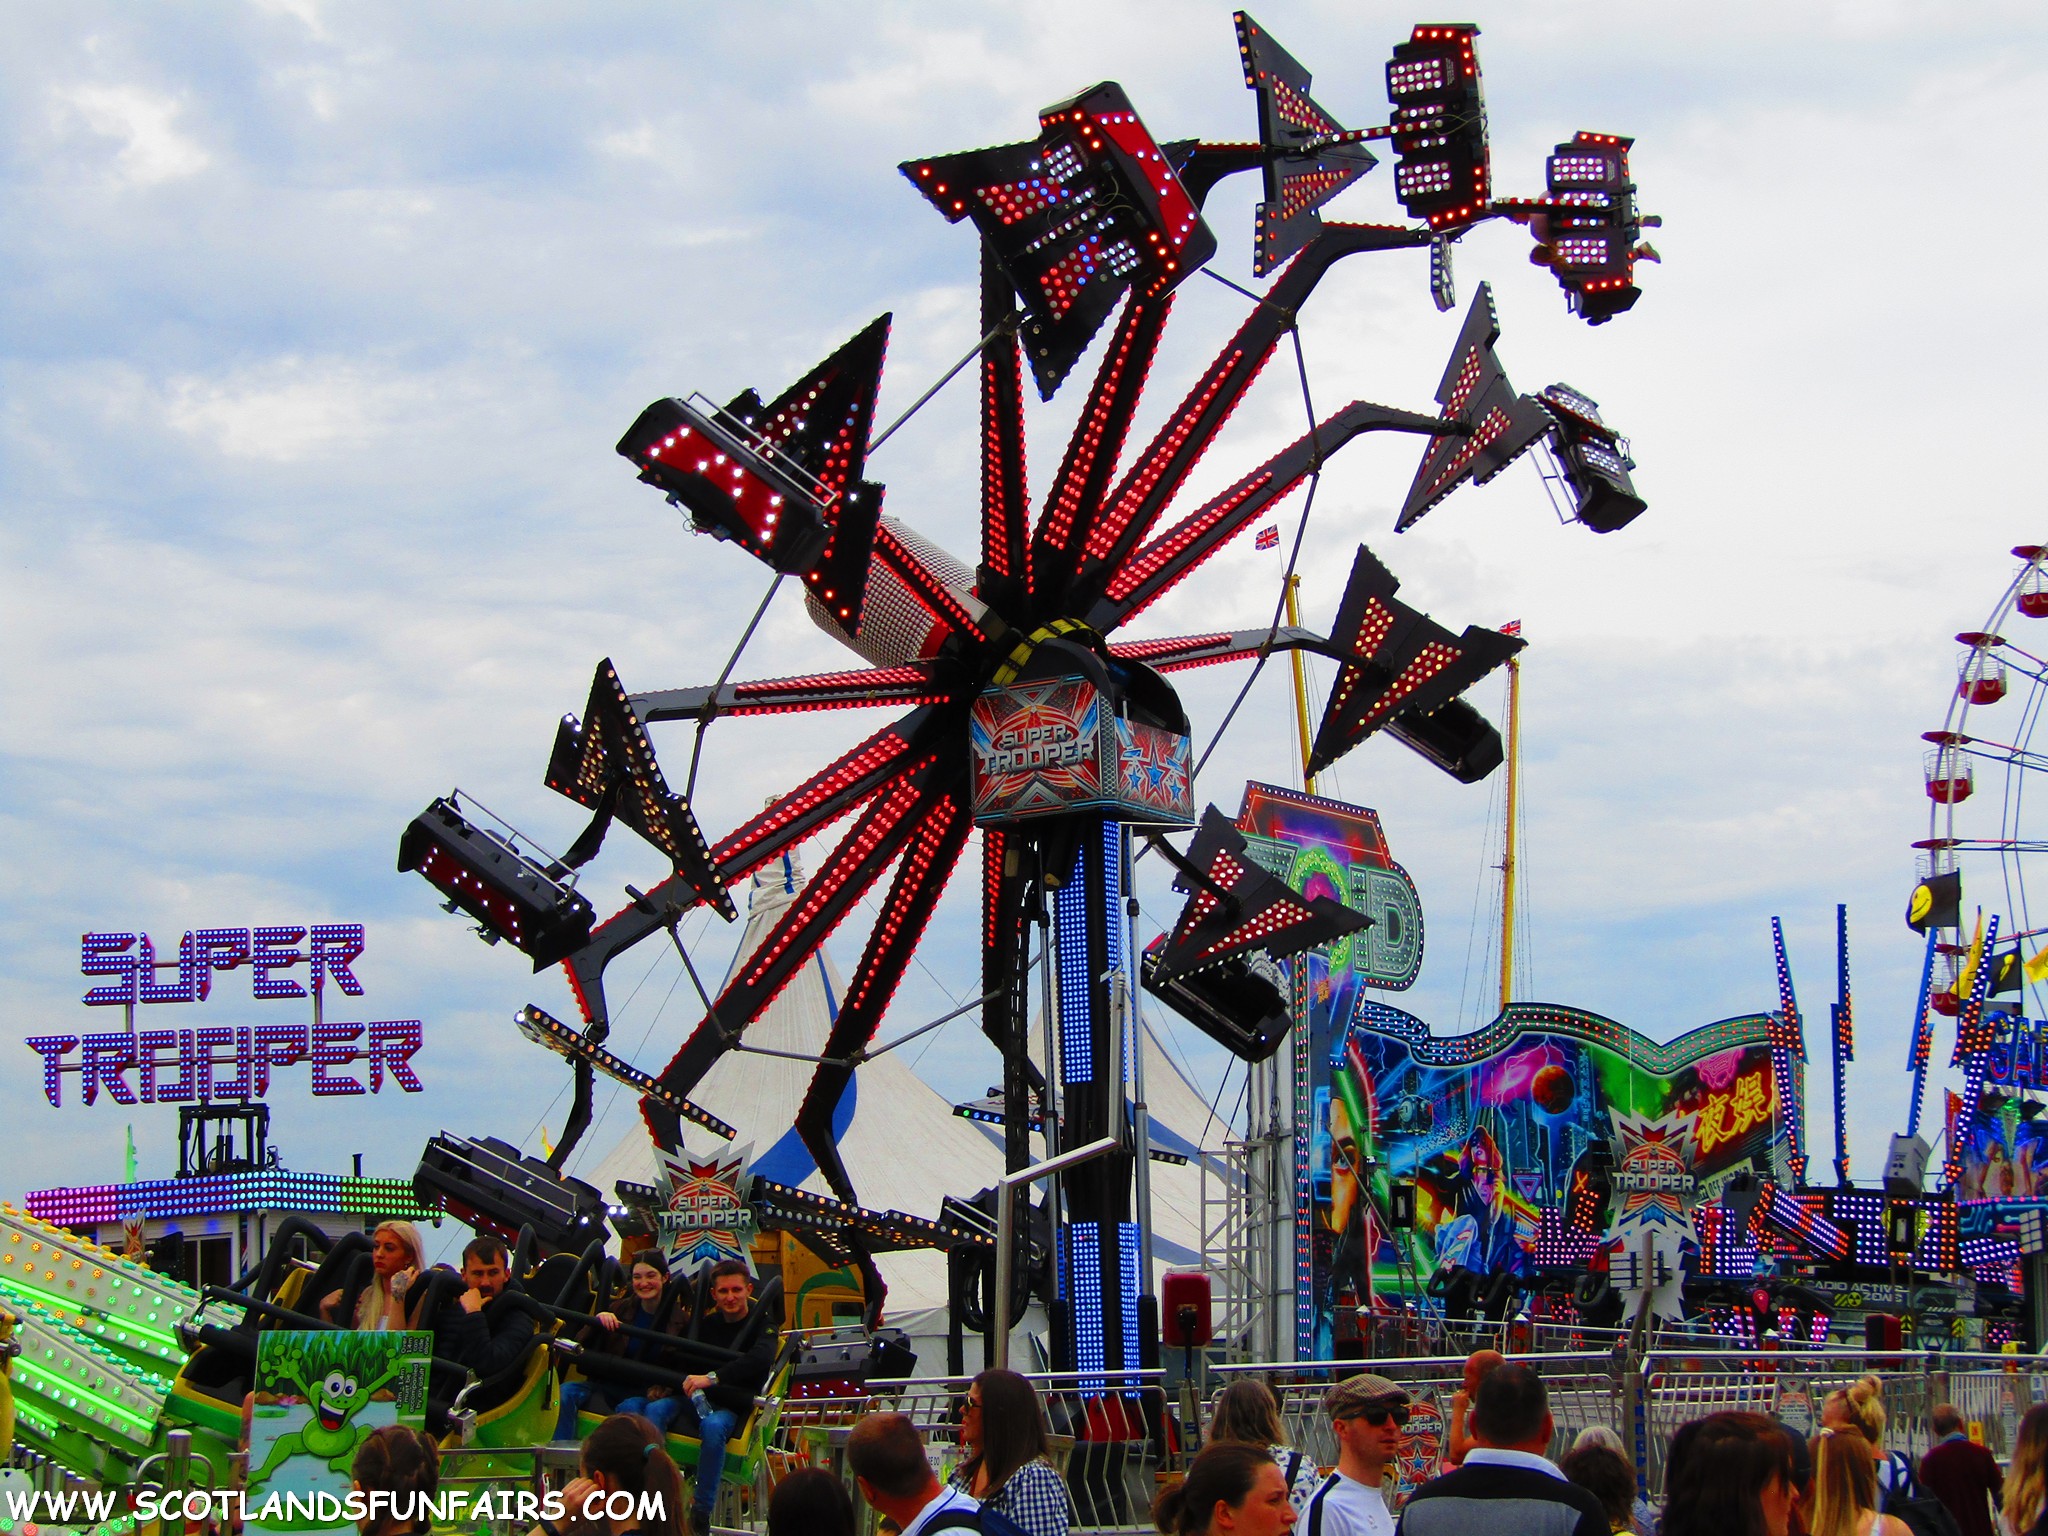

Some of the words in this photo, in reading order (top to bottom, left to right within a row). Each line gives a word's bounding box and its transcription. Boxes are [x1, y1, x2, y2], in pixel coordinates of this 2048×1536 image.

[1000, 725, 1072, 750] SUPER
[979, 740, 1095, 776] TROOPER
[81, 924, 365, 1007] SUPER
[24, 1020, 424, 1108] TROOPER
[1629, 1158, 1677, 1173] SUPER
[1611, 1172, 1696, 1192] TROOPER
[678, 1195, 730, 1210] SUPER
[658, 1208, 752, 1230] TROOPER
